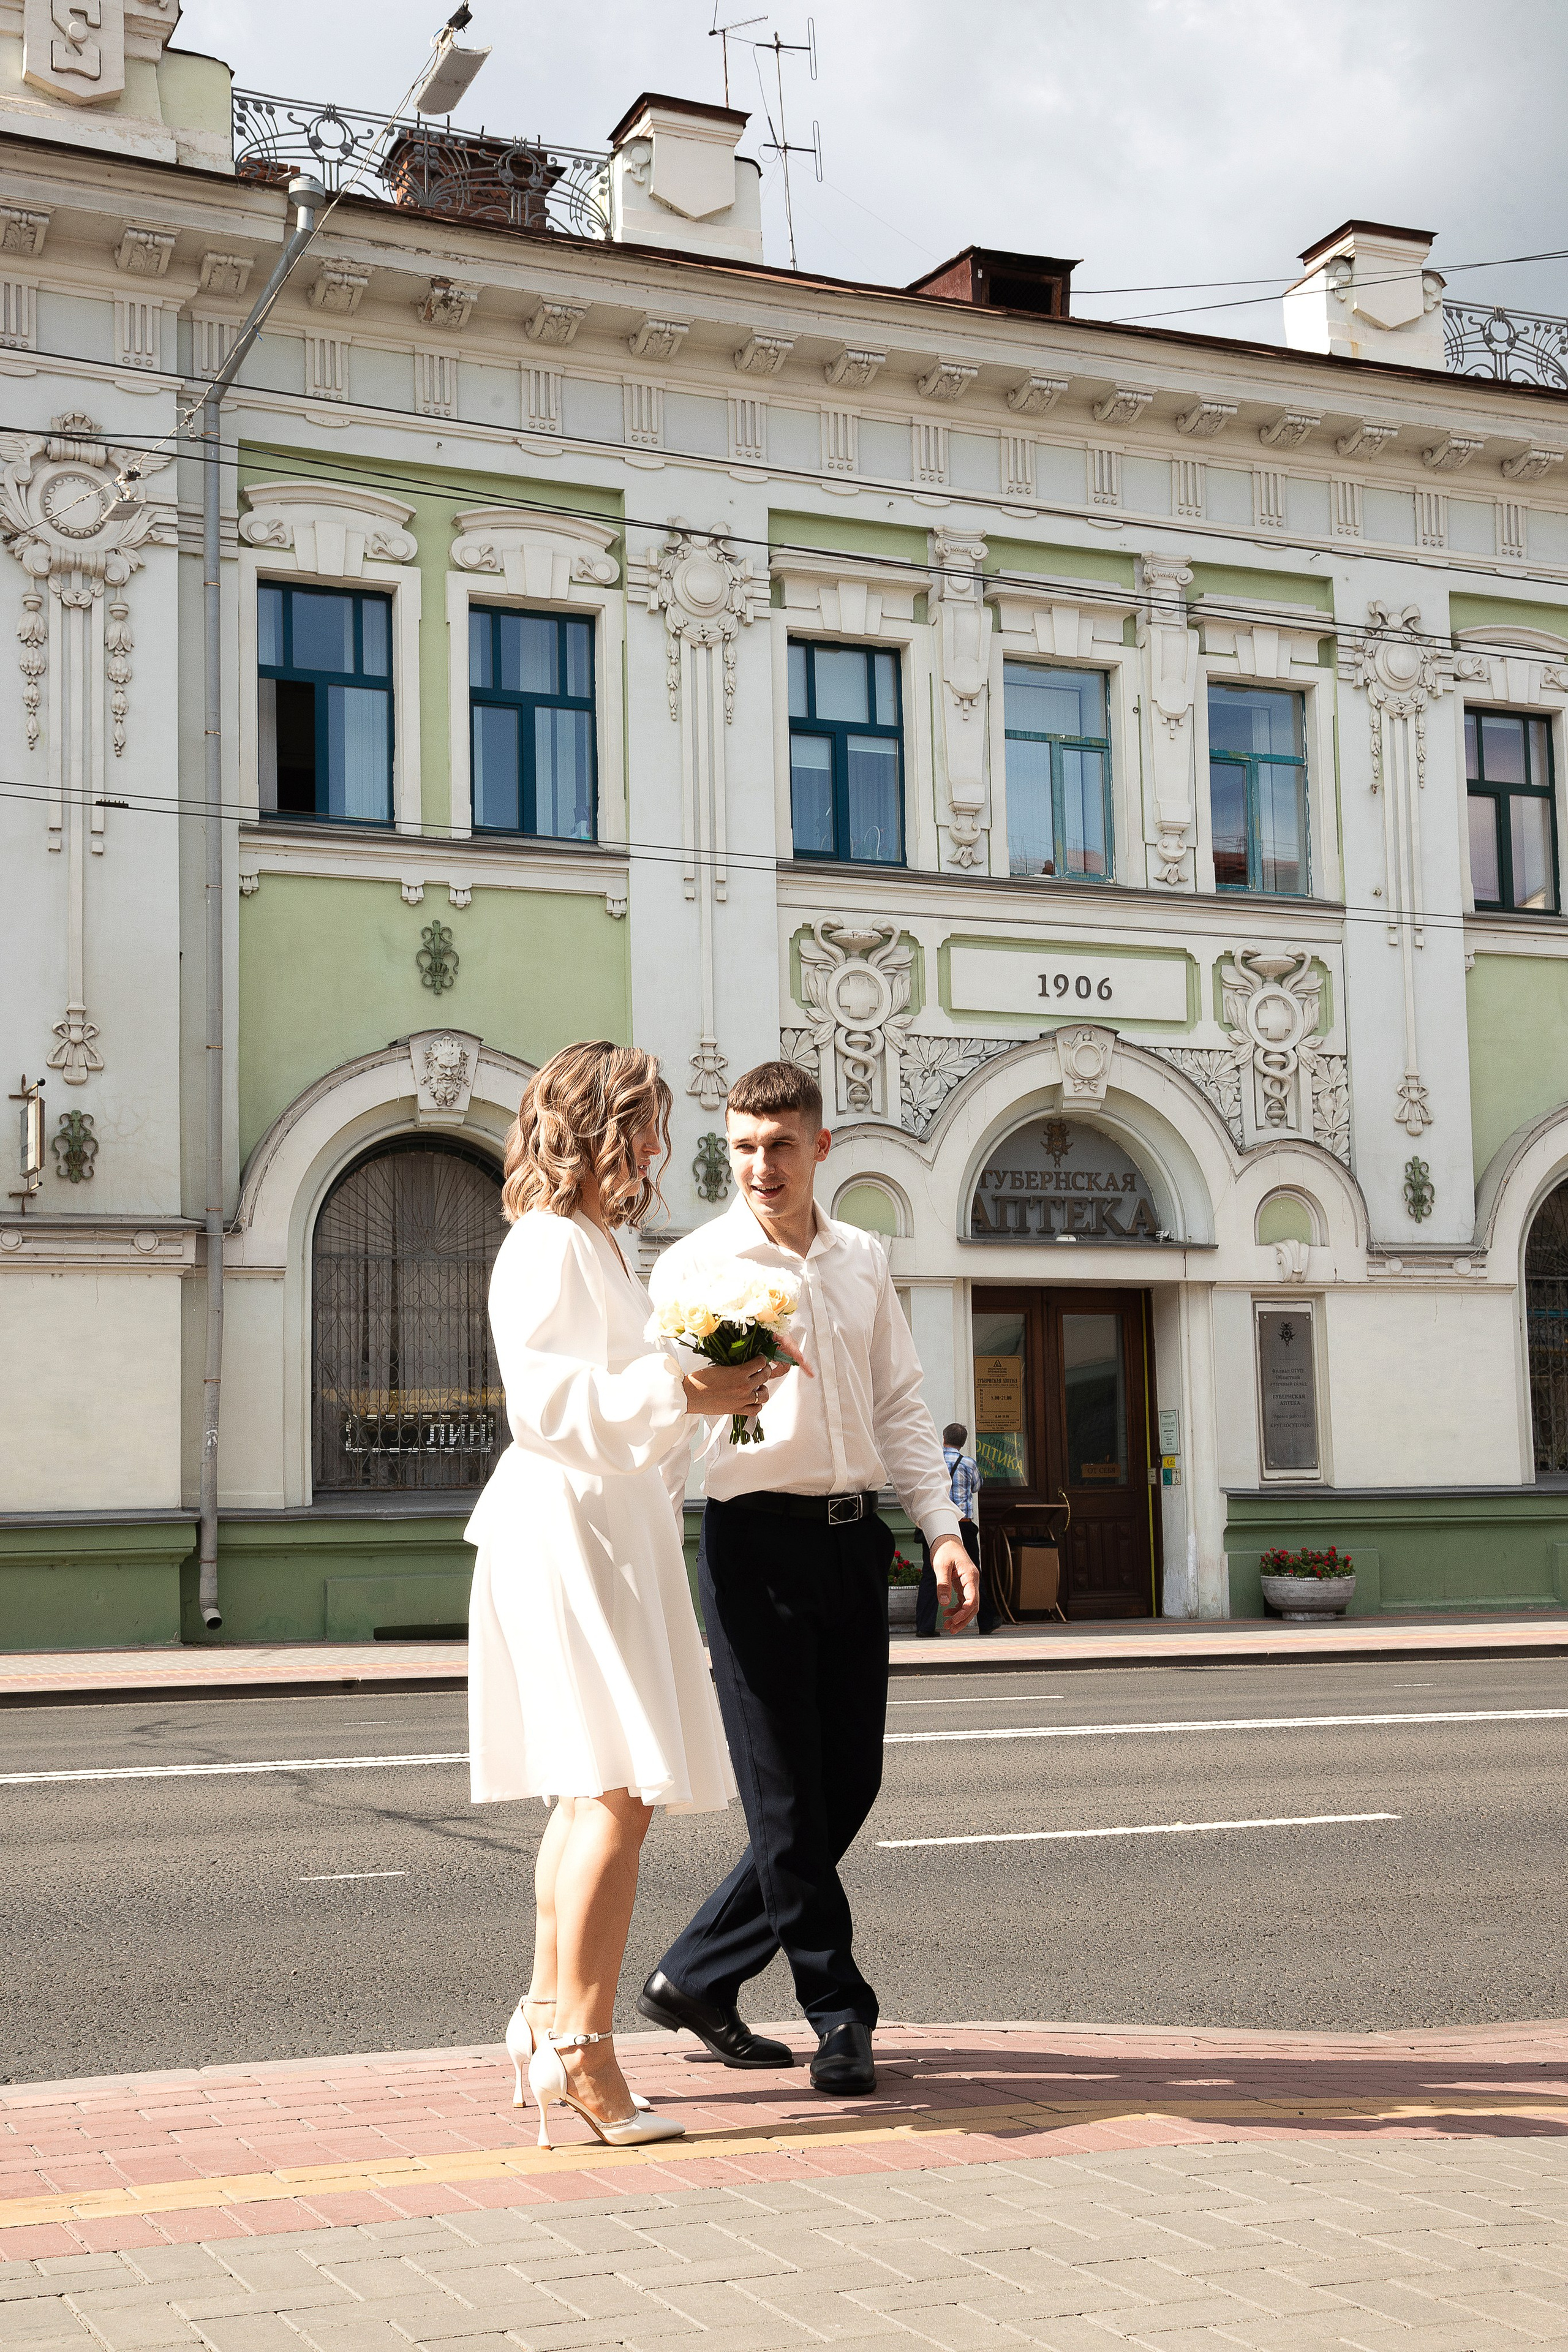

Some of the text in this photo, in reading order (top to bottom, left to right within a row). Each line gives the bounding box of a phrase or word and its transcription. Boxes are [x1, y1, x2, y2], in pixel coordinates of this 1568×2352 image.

[1038, 974, 1112, 1000] 1906
[980, 1169, 1137, 1192] ГУБЕРНСКАЯ
[971, 1194, 1160, 1235] АПТЕКА
